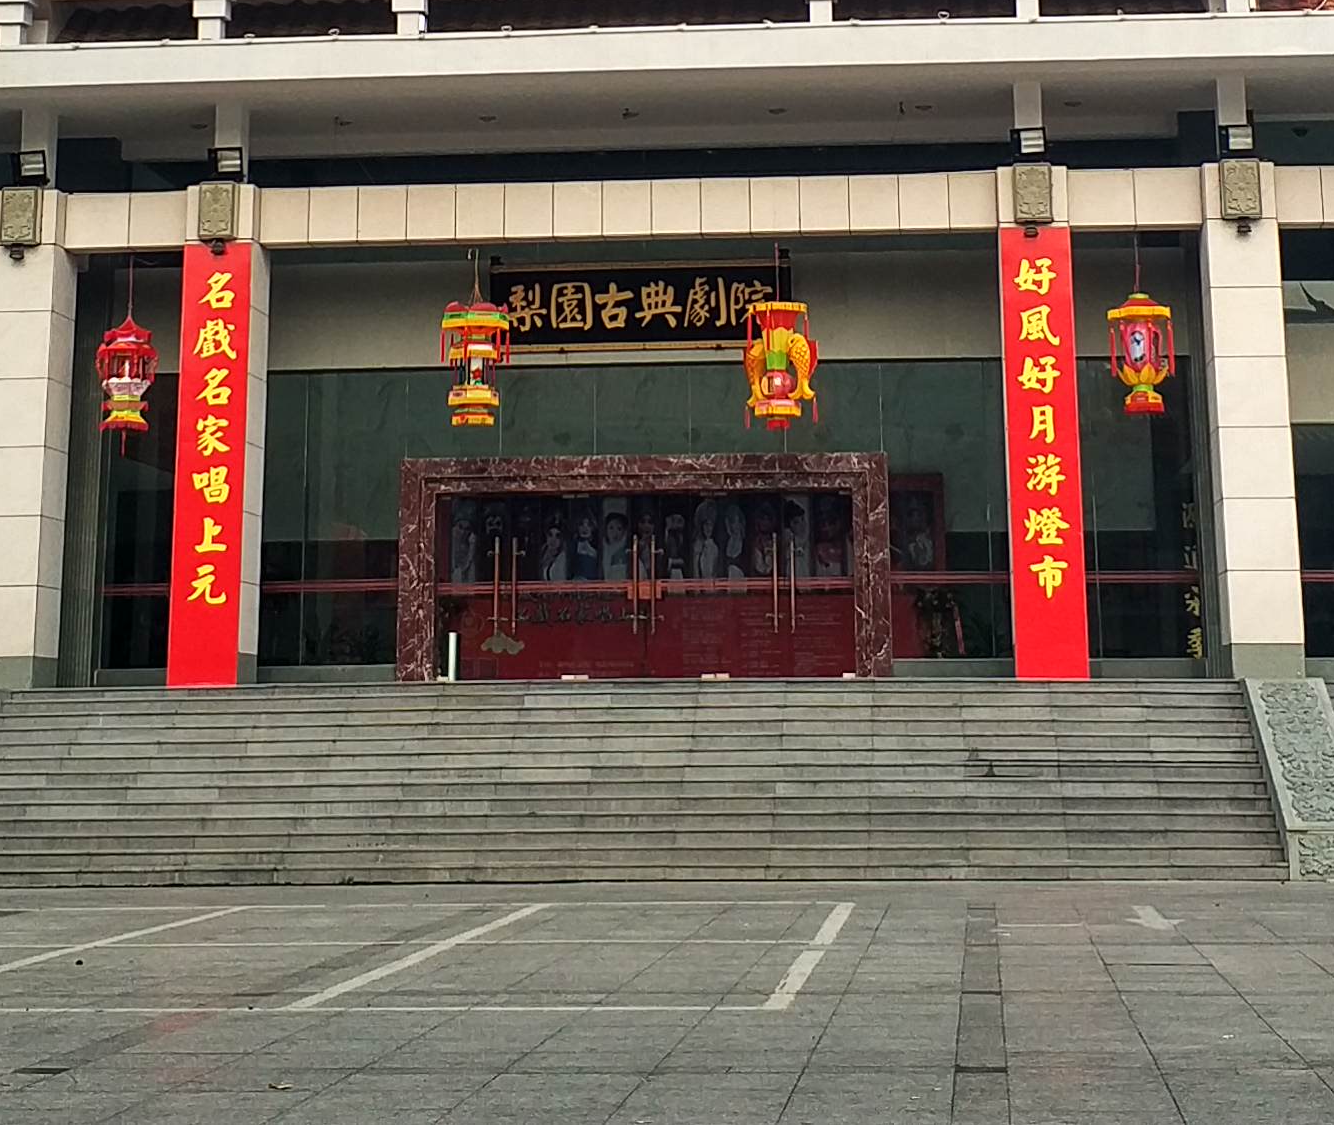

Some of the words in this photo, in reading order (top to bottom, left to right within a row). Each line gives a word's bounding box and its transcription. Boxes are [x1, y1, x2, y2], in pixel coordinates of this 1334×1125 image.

[186, 271, 238, 605] 名戲名家唱上元
[508, 276, 774, 332] 梨園古典劇院
[1013, 257, 1070, 599] 好風好月游燈市
